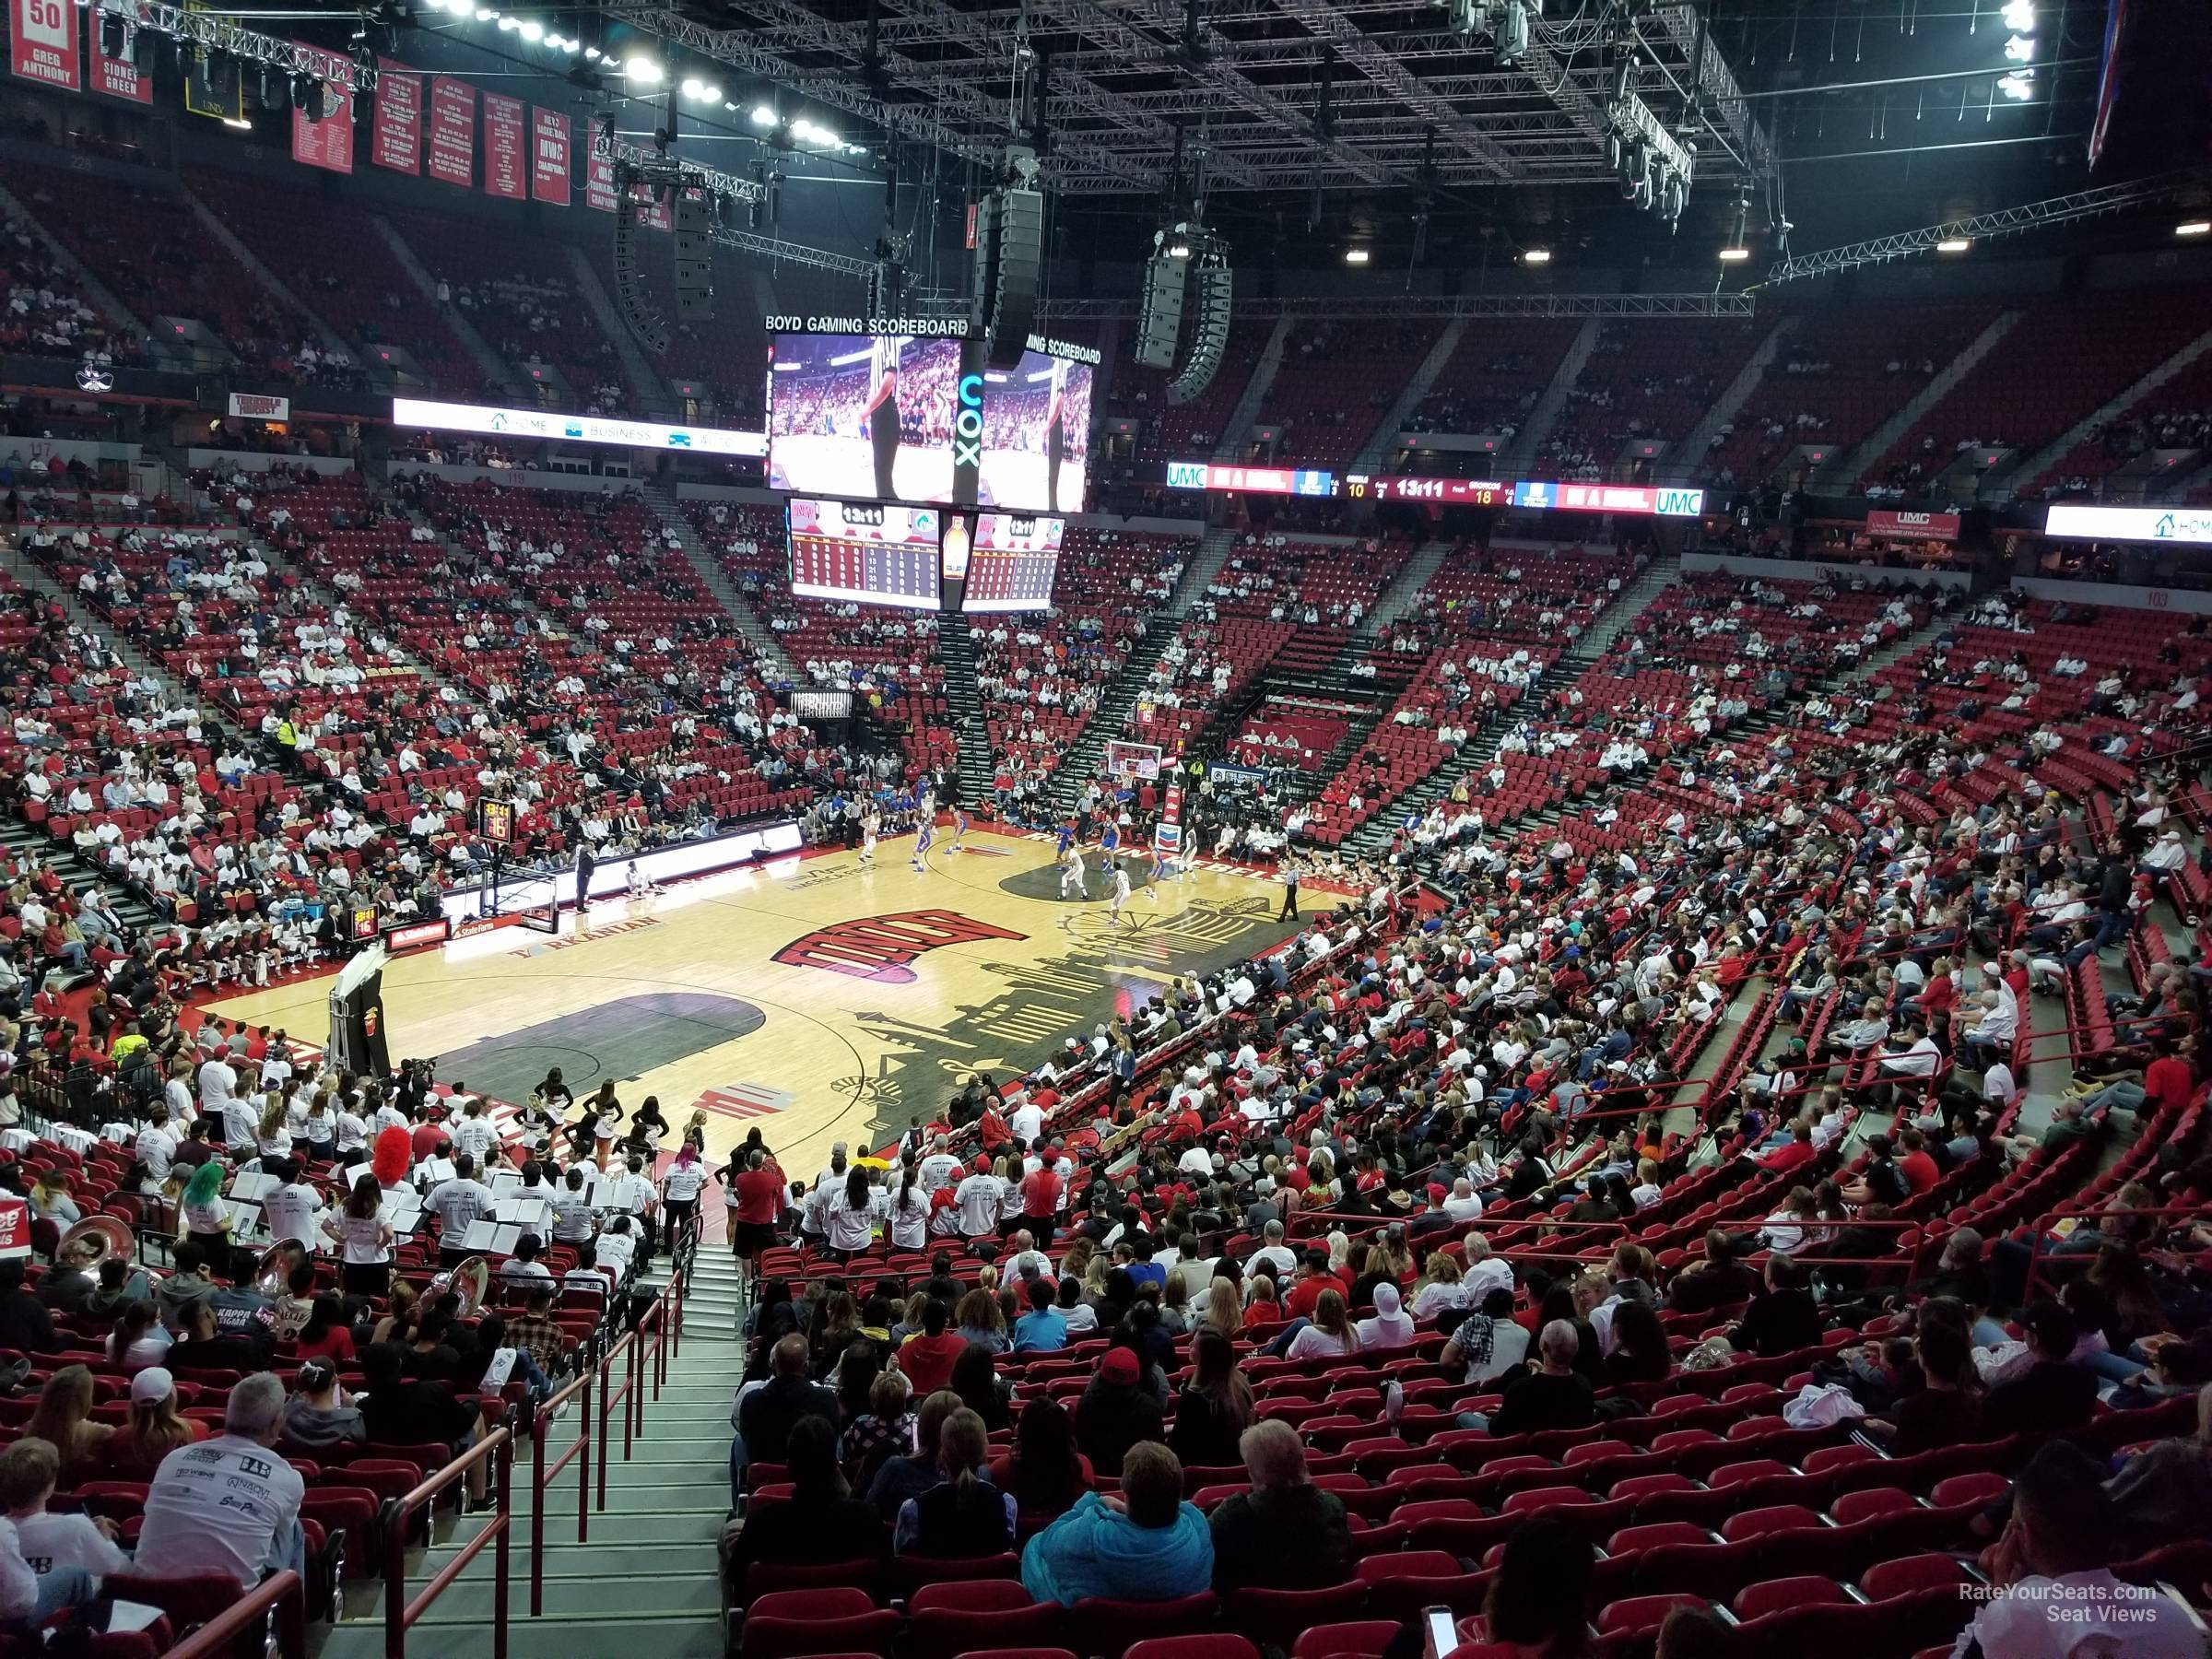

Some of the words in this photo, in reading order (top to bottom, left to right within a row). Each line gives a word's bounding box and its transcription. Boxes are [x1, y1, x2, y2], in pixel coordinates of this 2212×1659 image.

[29, 0, 61, 29] 50
[32, 48, 61, 67] GREG
[22, 60, 71, 84] ANTHONY
[103, 62, 137, 82] SIDNEY
[106, 76, 136, 95] GREEN
[765, 315, 802, 330] BOYD
[806, 317, 863, 333] GAMING
[868, 318, 968, 335] SCOREBOARD
[1047, 338, 1101, 365] SCOREBOARD
[955, 375, 983, 467] COX
[590, 425, 652, 441] BUSINESS
[508, 471, 524, 485] 119
[1168, 466, 1206, 487] UMC
[1348, 484, 1365, 498] 10
[1396, 478, 1444, 498] 13:11
[1476, 490, 1491, 504] 18
[1657, 492, 1700, 514] UMC
[842, 506, 884, 524] 13:11
[1897, 512, 1930, 524] UMC
[2179, 519, 2212, 535] HOM
[769, 909, 1032, 972] UNLV
[218, 1308, 252, 1320] KAPPA
[218, 1317, 247, 1327] SIGMA
